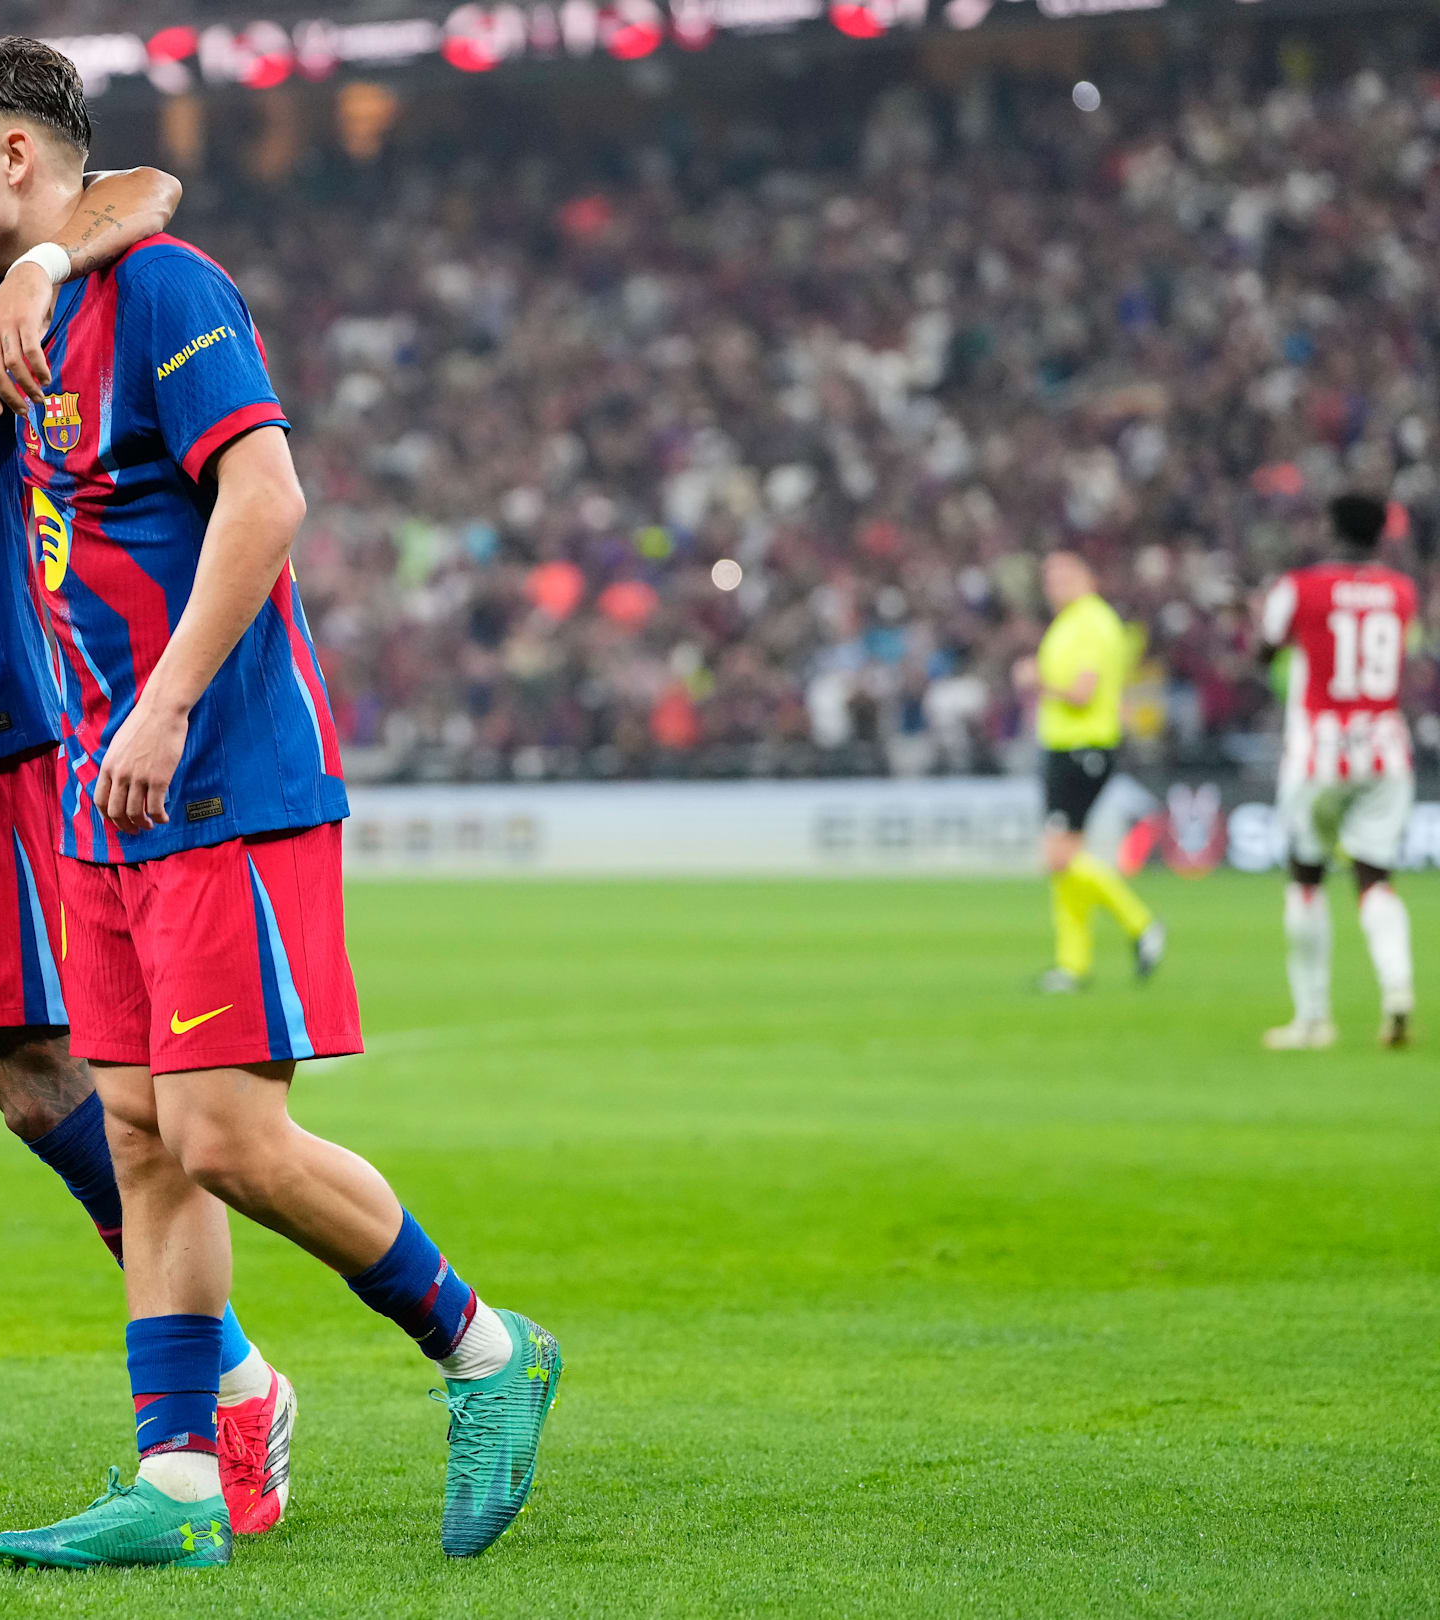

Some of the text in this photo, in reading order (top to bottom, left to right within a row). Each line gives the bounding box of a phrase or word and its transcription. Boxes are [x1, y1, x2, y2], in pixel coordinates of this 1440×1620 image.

[157, 326, 227, 381] AMBILIGHT
[55, 417, 71, 425] FCB
[1327, 610, 1399, 700] 19
